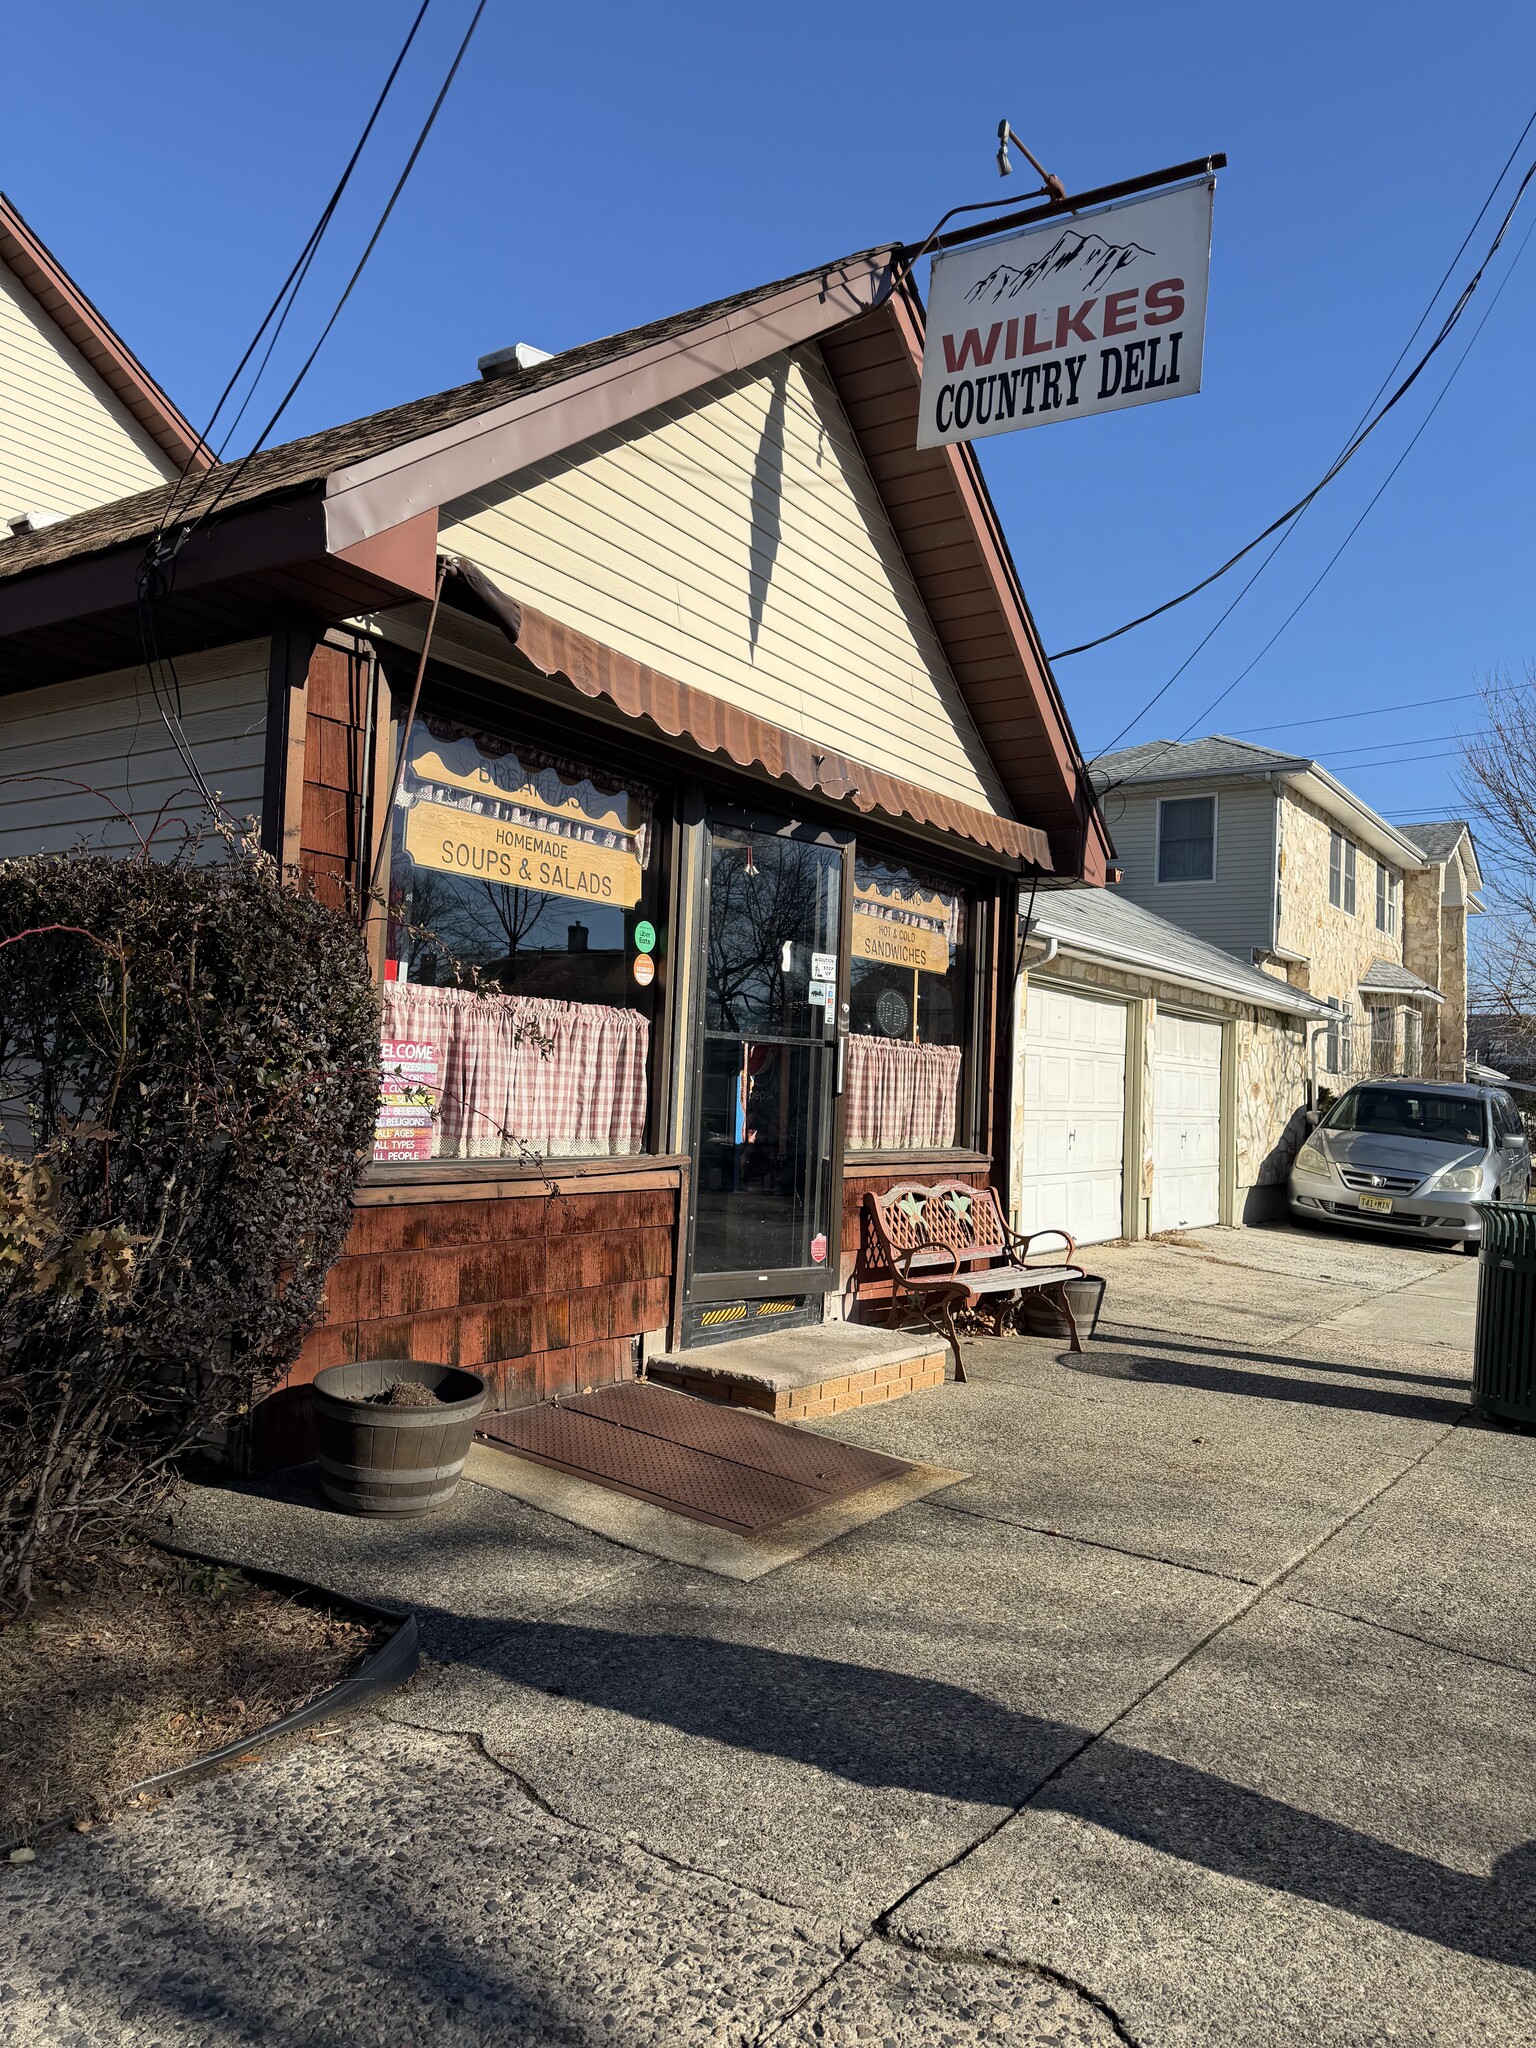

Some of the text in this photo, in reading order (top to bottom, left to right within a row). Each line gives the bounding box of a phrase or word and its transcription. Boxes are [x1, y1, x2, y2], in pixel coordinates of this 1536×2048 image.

[941, 277, 1186, 374] WILKES
[935, 331, 1183, 433] COUNTRY DELI
[496, 828, 569, 860] HOMEMADE
[441, 840, 612, 897] SOUPS & SALADS
[639, 930, 651, 938] Uber
[639, 937, 651, 945] Eats
[878, 925, 916, 943] HOT & COLD
[864, 937, 927, 966] SANDWICHES
[380, 1043, 434, 1060] ELCOME
[386, 1117, 425, 1126] RELIGIONS
[378, 1129, 415, 1138] ALL AGES
[374, 1140, 415, 1150] ALL TYPES
[388, 1151, 419, 1161] PEOPLE
